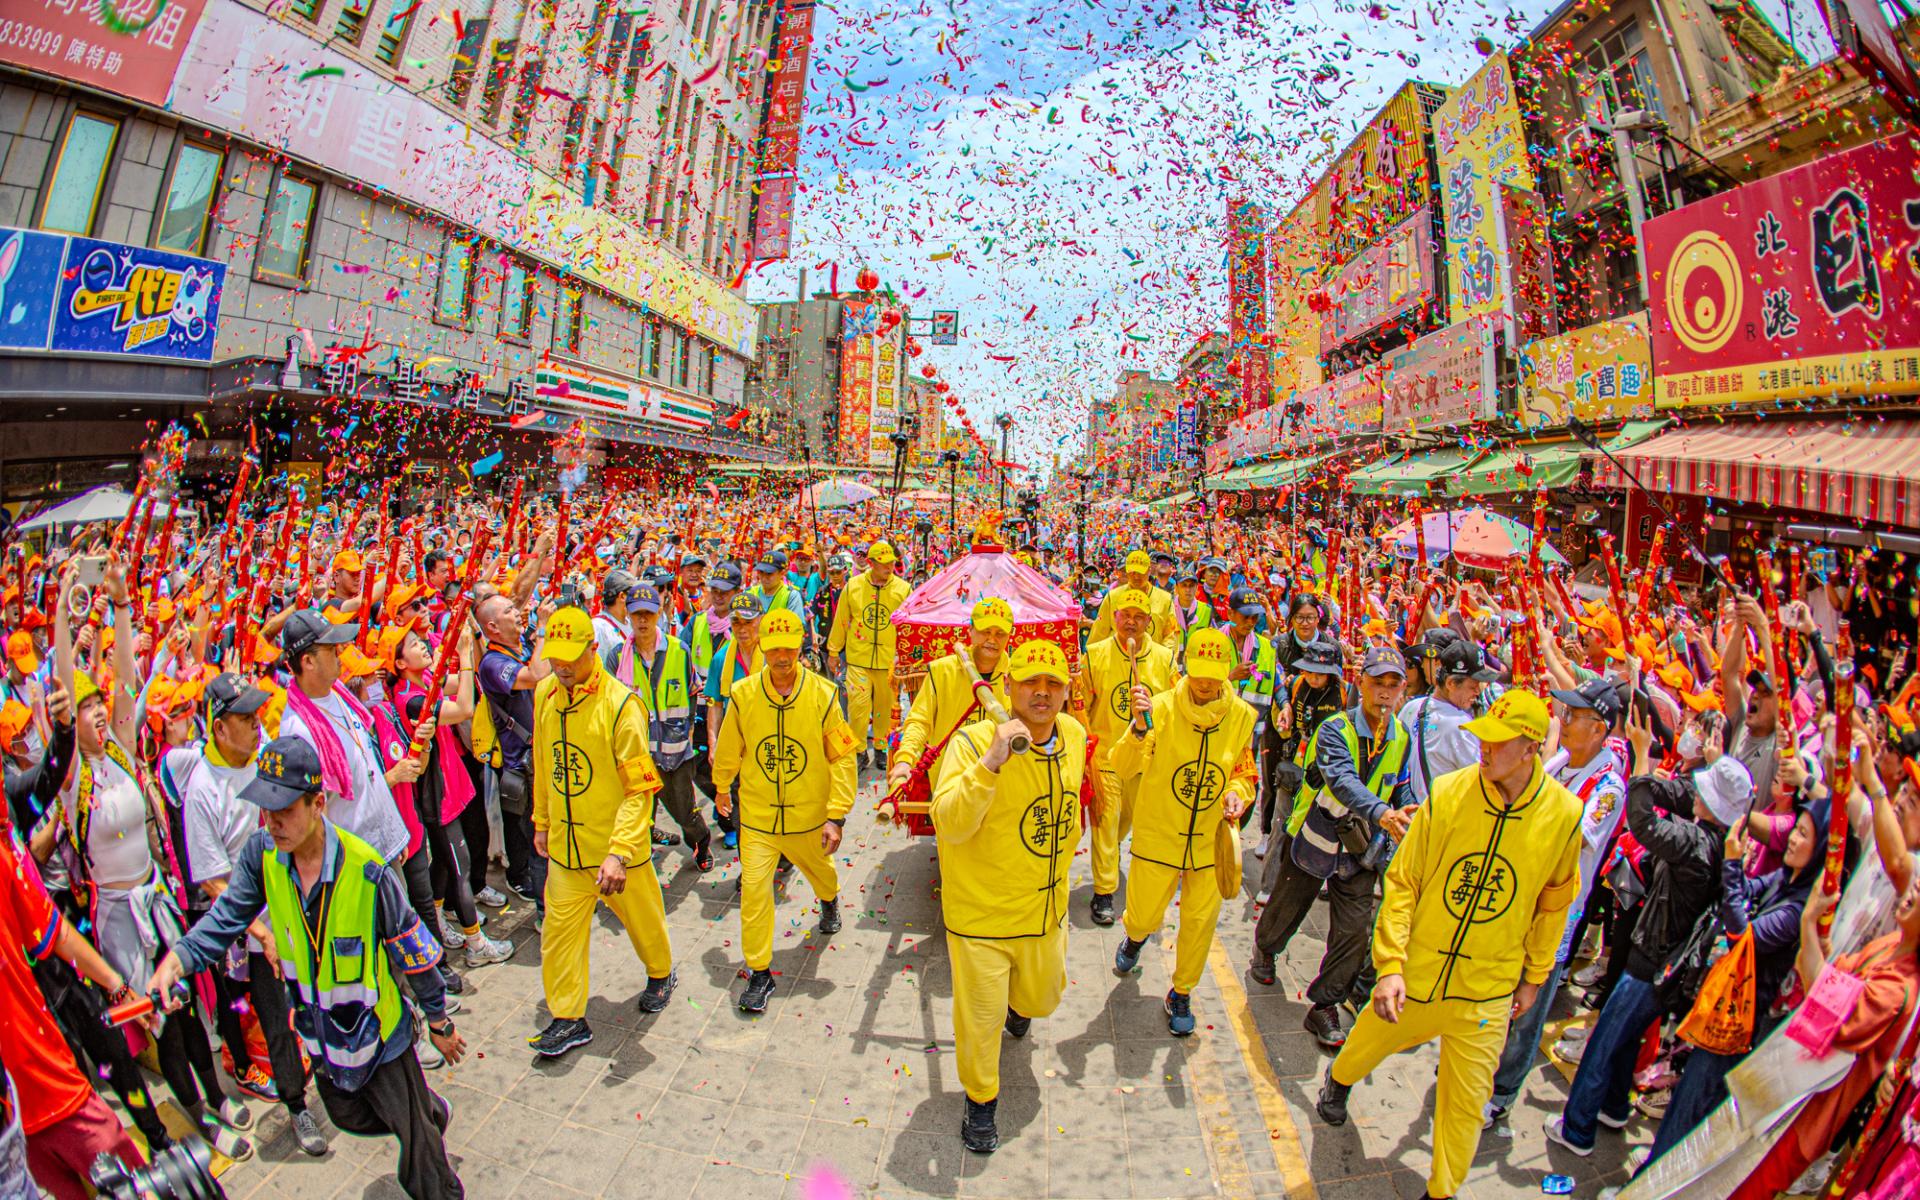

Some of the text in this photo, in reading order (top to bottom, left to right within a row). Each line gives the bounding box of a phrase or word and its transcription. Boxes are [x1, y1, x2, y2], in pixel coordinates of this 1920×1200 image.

[0, 18, 123, 76] 833999 陳特助
[1755, 210, 1801, 341] 北港
[568, 751, 584, 787] 天上
[763, 742, 777, 773] 聖母
[784, 744, 798, 775] 天上
[1180, 767, 1197, 798] 聖母
[1201, 769, 1218, 801] 天上
[1031, 805, 1050, 847] 聖母
[1451, 860, 1480, 906] 聖母
[1477, 868, 1505, 913] 天上
